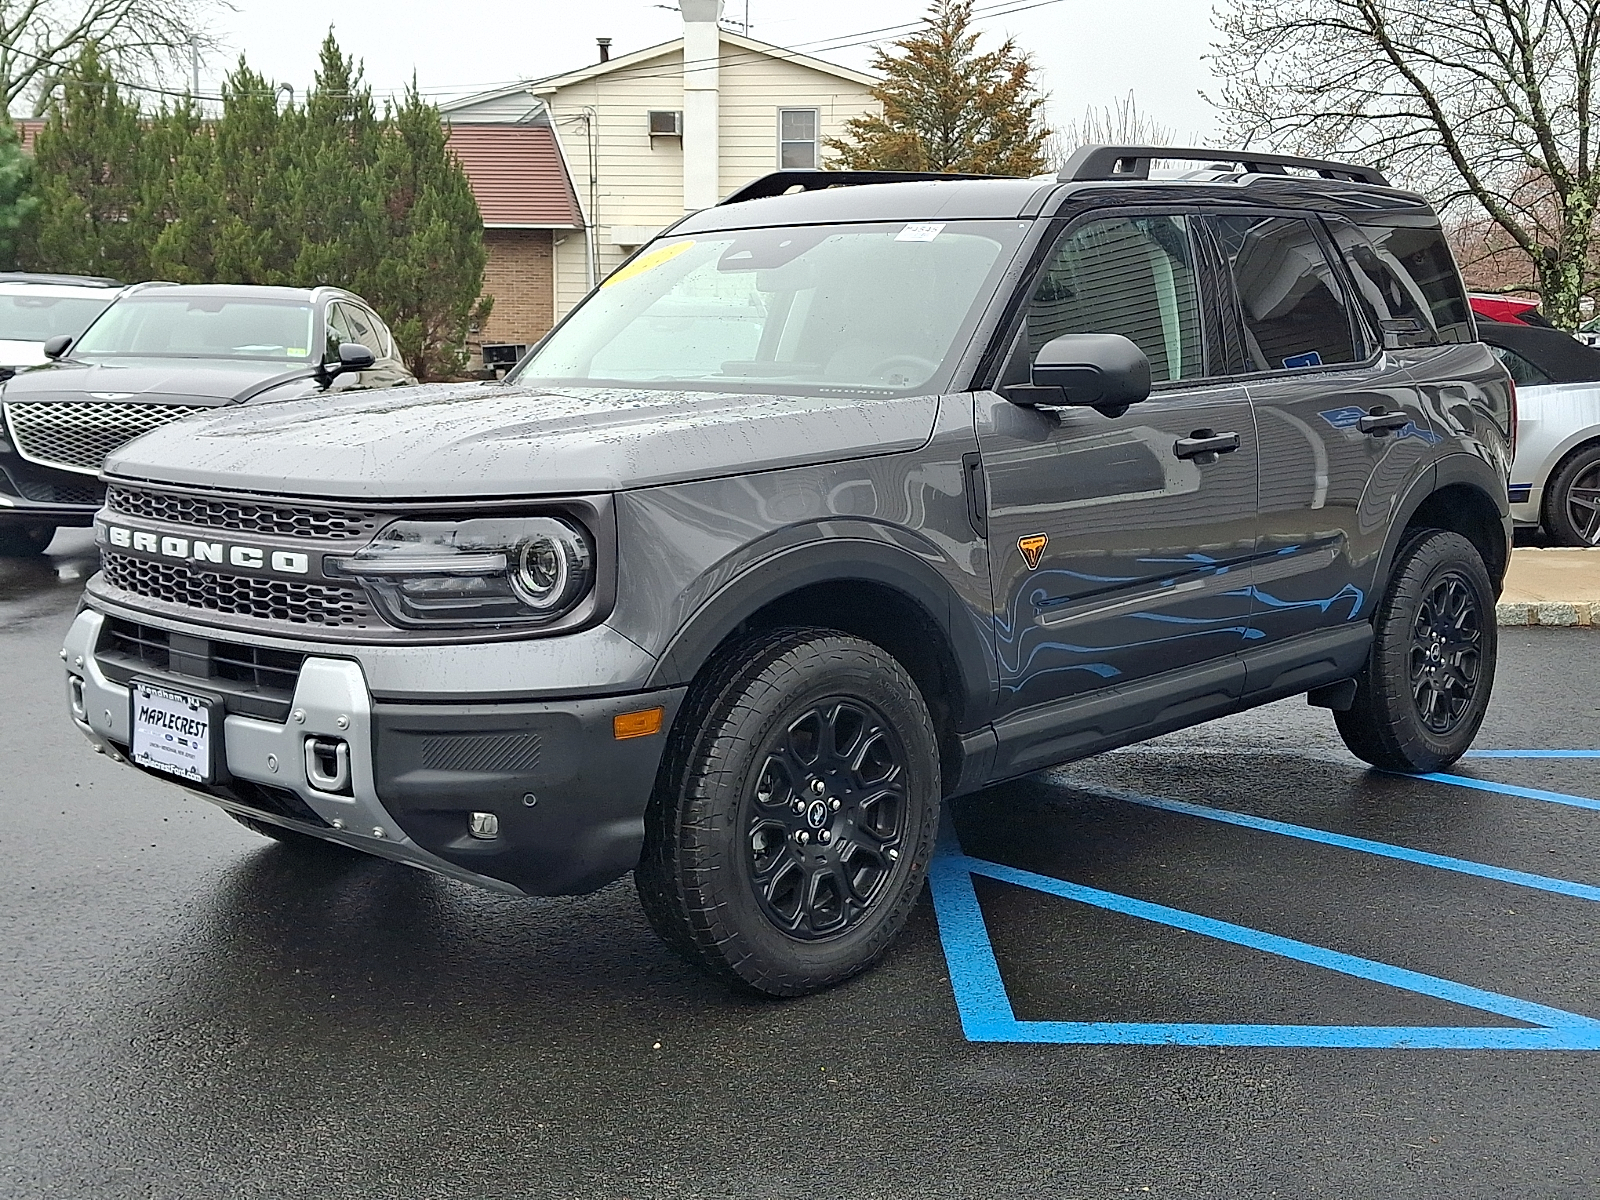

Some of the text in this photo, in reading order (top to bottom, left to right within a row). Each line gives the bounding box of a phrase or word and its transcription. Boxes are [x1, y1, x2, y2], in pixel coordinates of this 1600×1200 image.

[109, 526, 309, 574] BRONCO
[138, 706, 207, 738] MAPLECREST
[135, 753, 202, 783] MaplecrestFord.com
